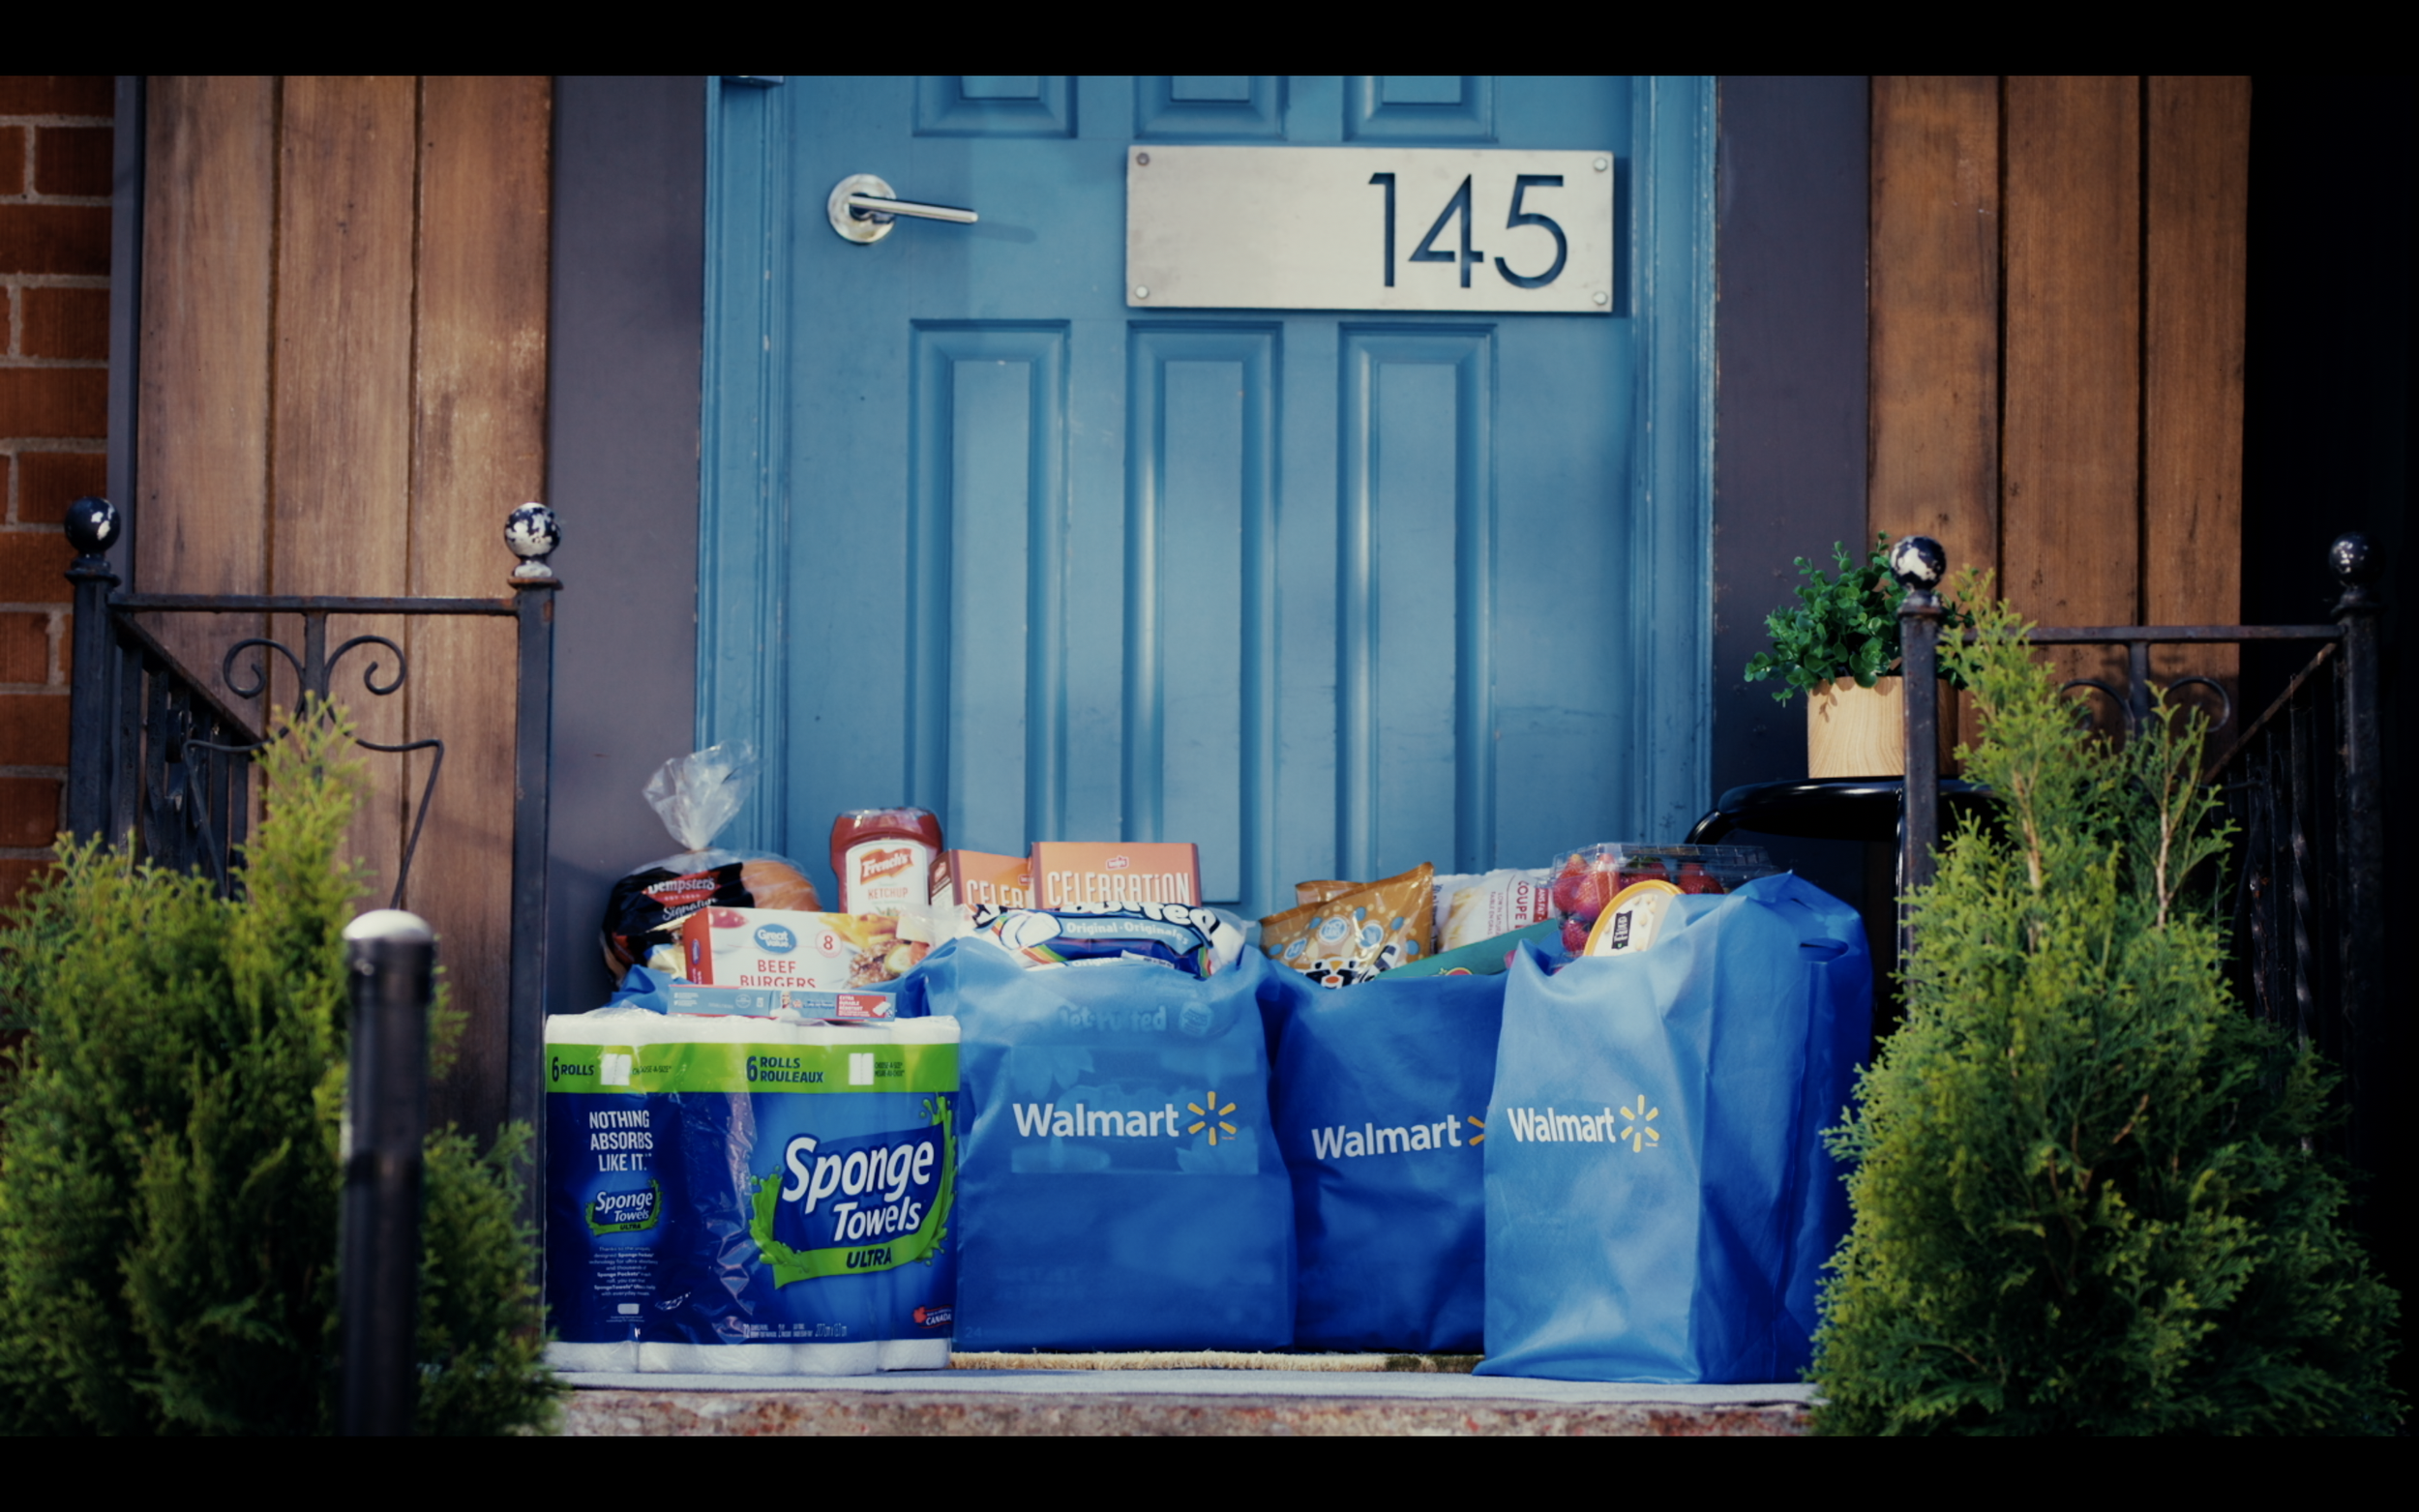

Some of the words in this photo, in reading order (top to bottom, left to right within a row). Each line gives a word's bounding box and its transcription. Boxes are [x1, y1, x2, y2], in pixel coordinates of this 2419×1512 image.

[1368, 172, 1568, 289] 145
[868, 887, 908, 900] KETCHUP
[1047, 871, 1190, 906] CELEBRATION
[757, 929, 789, 941] Great
[823, 935, 833, 950] 8
[1066, 922, 1118, 934] Original
[1124, 921, 1190, 945] Originales
[758, 960, 796, 973] BEEF
[740, 975, 816, 988] BURGERS
[552, 1056, 559, 1082] 6
[561, 1064, 594, 1076] ROLLS
[746, 1055, 759, 1082] 6
[760, 1056, 800, 1069] ROLLS
[760, 1070, 823, 1083] ROULEAUX
[589, 1110, 650, 1129] NOTHING
[1012, 1103, 1180, 1138] Walmart
[1508, 1108, 1616, 1142] Walmart
[590, 1131, 653, 1151] ABSORBS
[1311, 1114, 1462, 1160] Walmart
[598, 1153, 628, 1171] LIKE
[782, 1137, 935, 1214] Sponge
[595, 1191, 653, 1214] Sponge
[613, 1208, 649, 1222] Towels
[833, 1196, 921, 1241] Towels
[846, 1247, 892, 1268] ULTRA
[926, 1313, 952, 1325] CANADA
